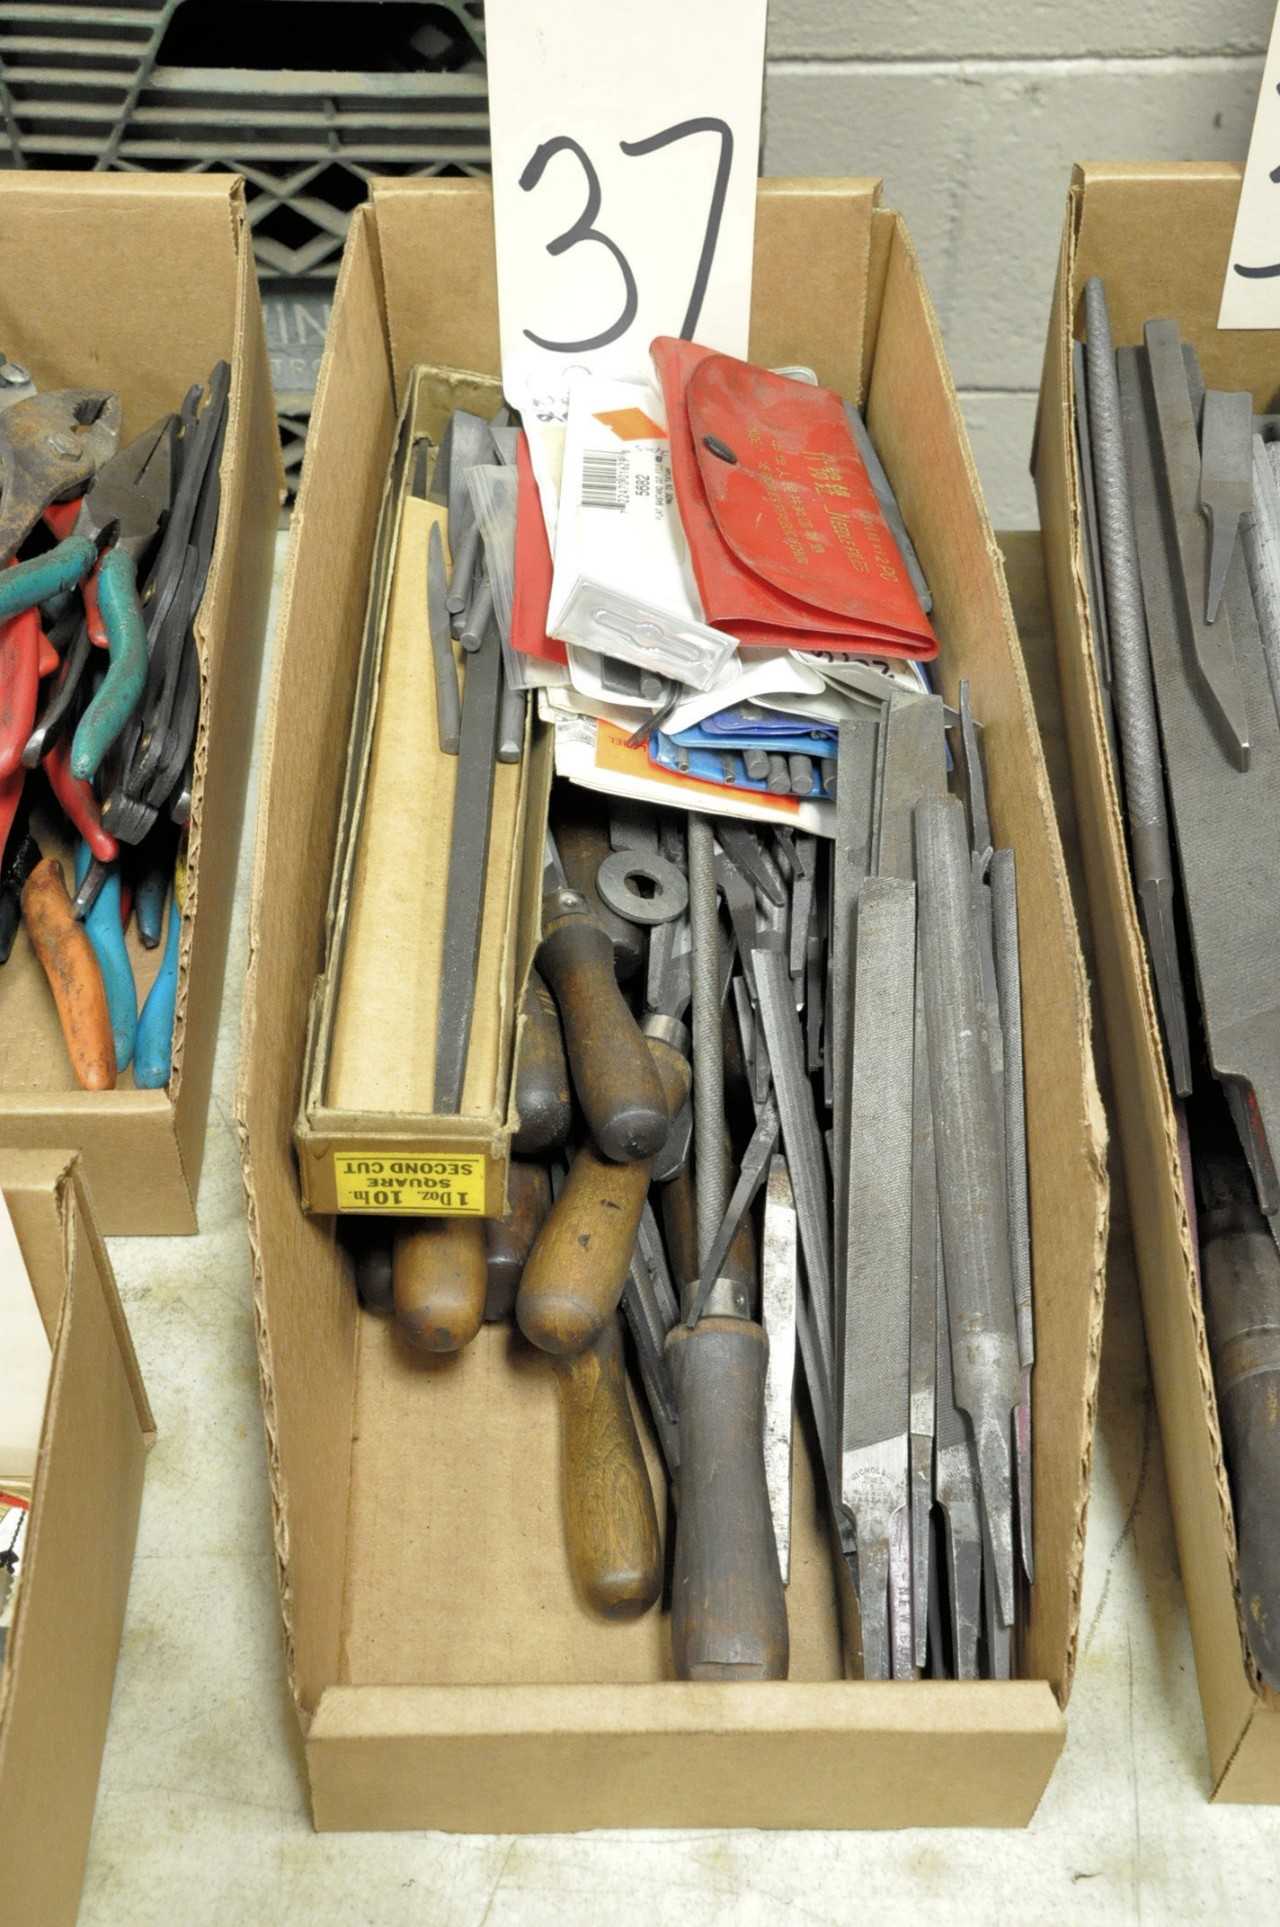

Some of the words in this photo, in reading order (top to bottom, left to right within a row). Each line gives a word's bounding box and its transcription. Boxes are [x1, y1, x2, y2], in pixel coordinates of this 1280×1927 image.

[518, 116, 735, 353] 37
[343, 1161, 385, 1175] CUT
[389, 1162, 473, 1176] SECOND
[367, 1177, 452, 1189] SQUARE
[373, 1190, 403, 1205] 10
[456, 1191, 470, 1206] 1
